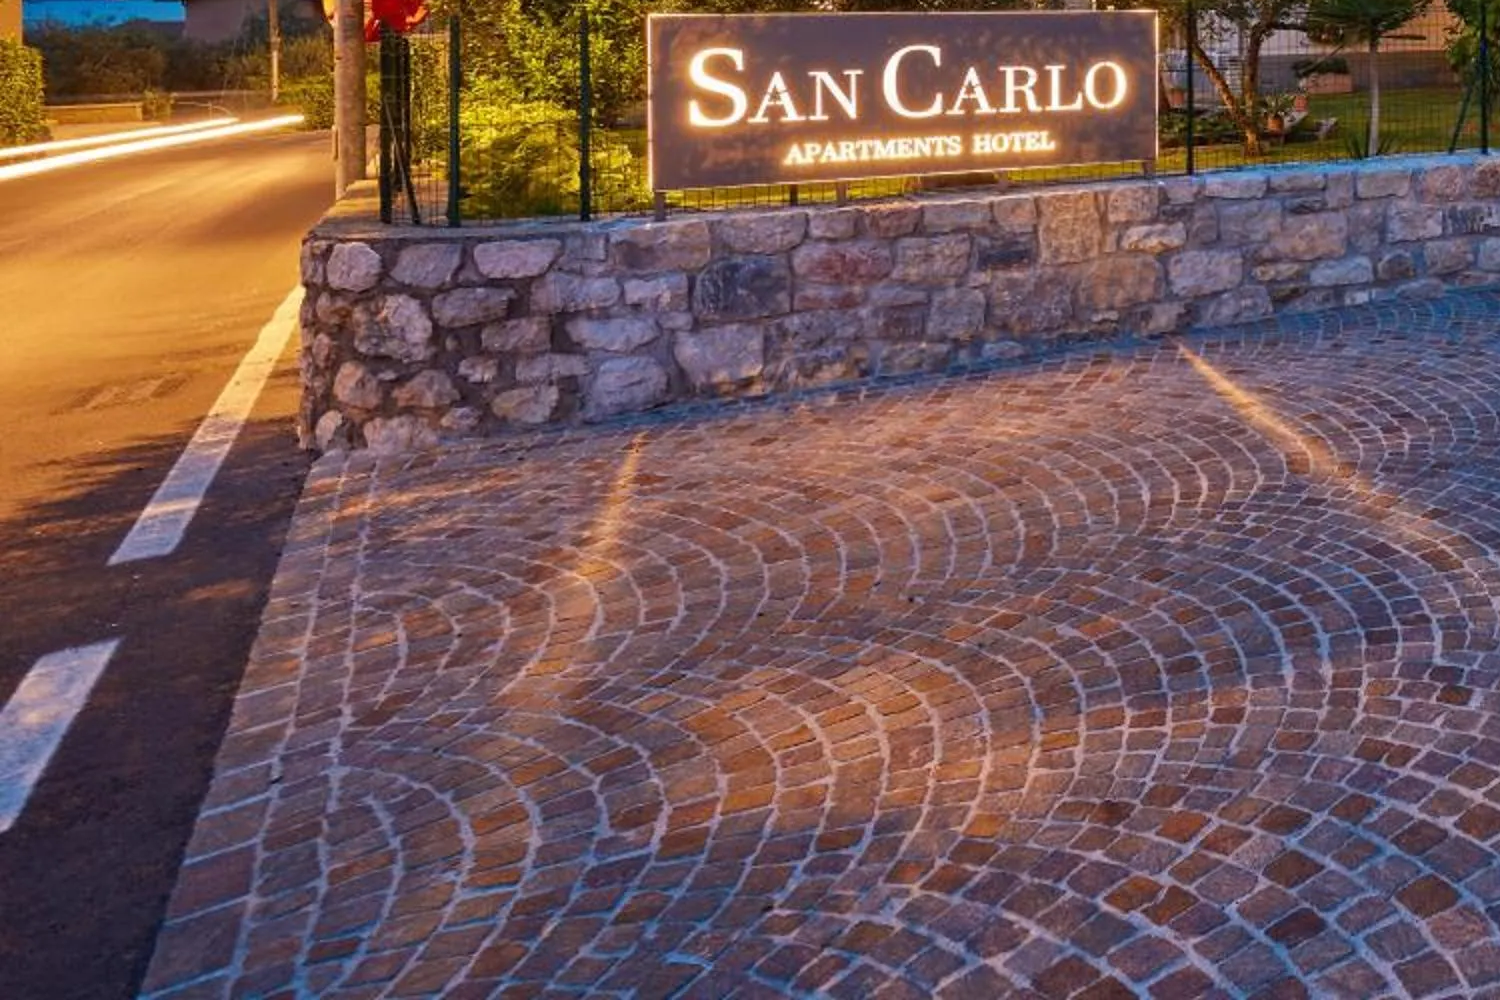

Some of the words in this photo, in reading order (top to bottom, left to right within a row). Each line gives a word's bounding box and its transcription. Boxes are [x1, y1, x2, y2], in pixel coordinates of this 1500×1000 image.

[687, 45, 864, 128] SAN
[882, 44, 1128, 119] CARLO
[783, 135, 962, 166] APARTMENTS
[972, 131, 1056, 155] HOTEL
